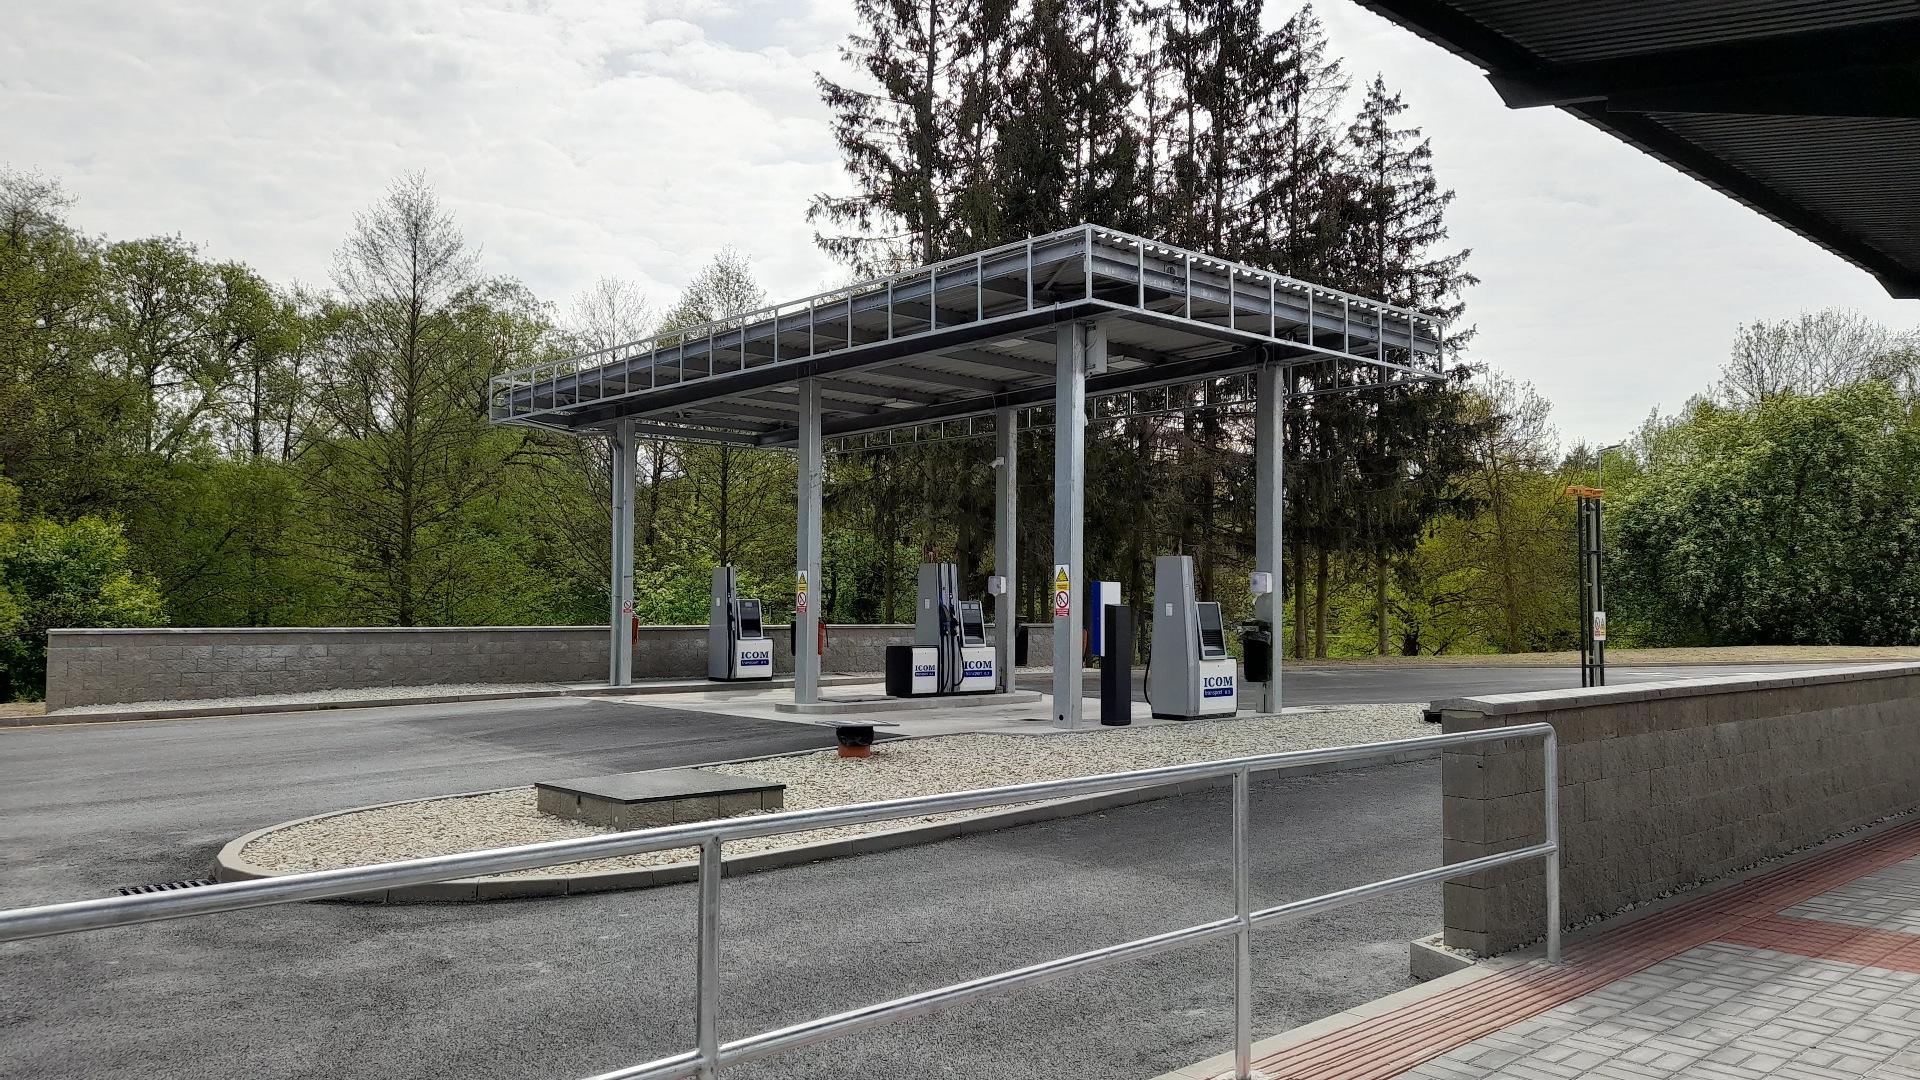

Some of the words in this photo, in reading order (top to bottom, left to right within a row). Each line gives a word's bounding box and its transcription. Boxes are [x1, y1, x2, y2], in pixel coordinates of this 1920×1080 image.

[741, 651, 769, 659] ICOM
[964, 661, 992, 669] ICOM
[1204, 676, 1233, 687] ICOM
